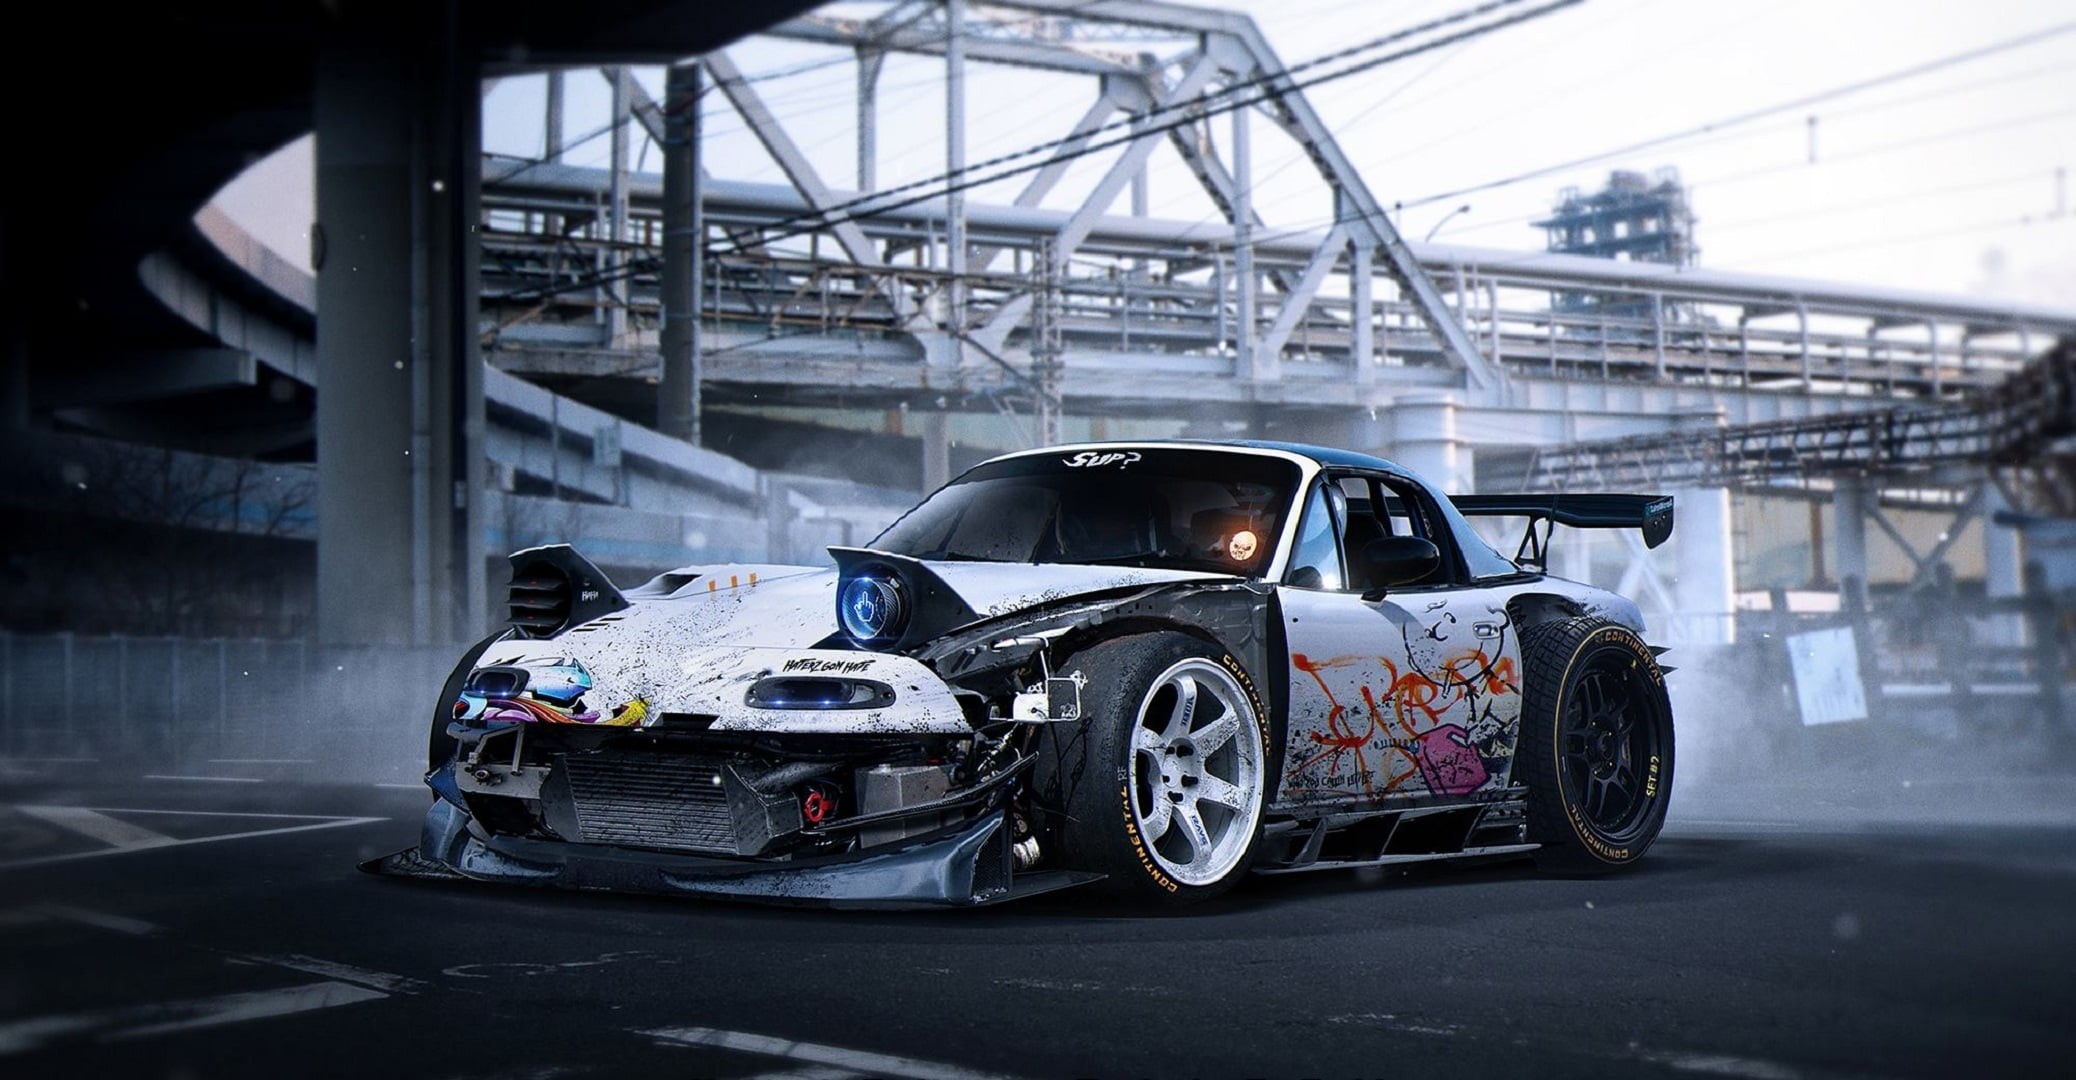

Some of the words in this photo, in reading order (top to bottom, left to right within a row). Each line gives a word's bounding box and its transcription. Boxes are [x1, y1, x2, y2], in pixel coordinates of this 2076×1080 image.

[1062, 451, 1142, 470] SUP?
[782, 658, 822, 674] HATERZ
[841, 659, 877, 675] HATE
[1604, 631, 1662, 687] CONTINENTAL
[1646, 775, 1657, 798] SET
[1120, 785, 1178, 893] CONTINENTAL
[1571, 803, 1629, 860] CONTINENTAL
